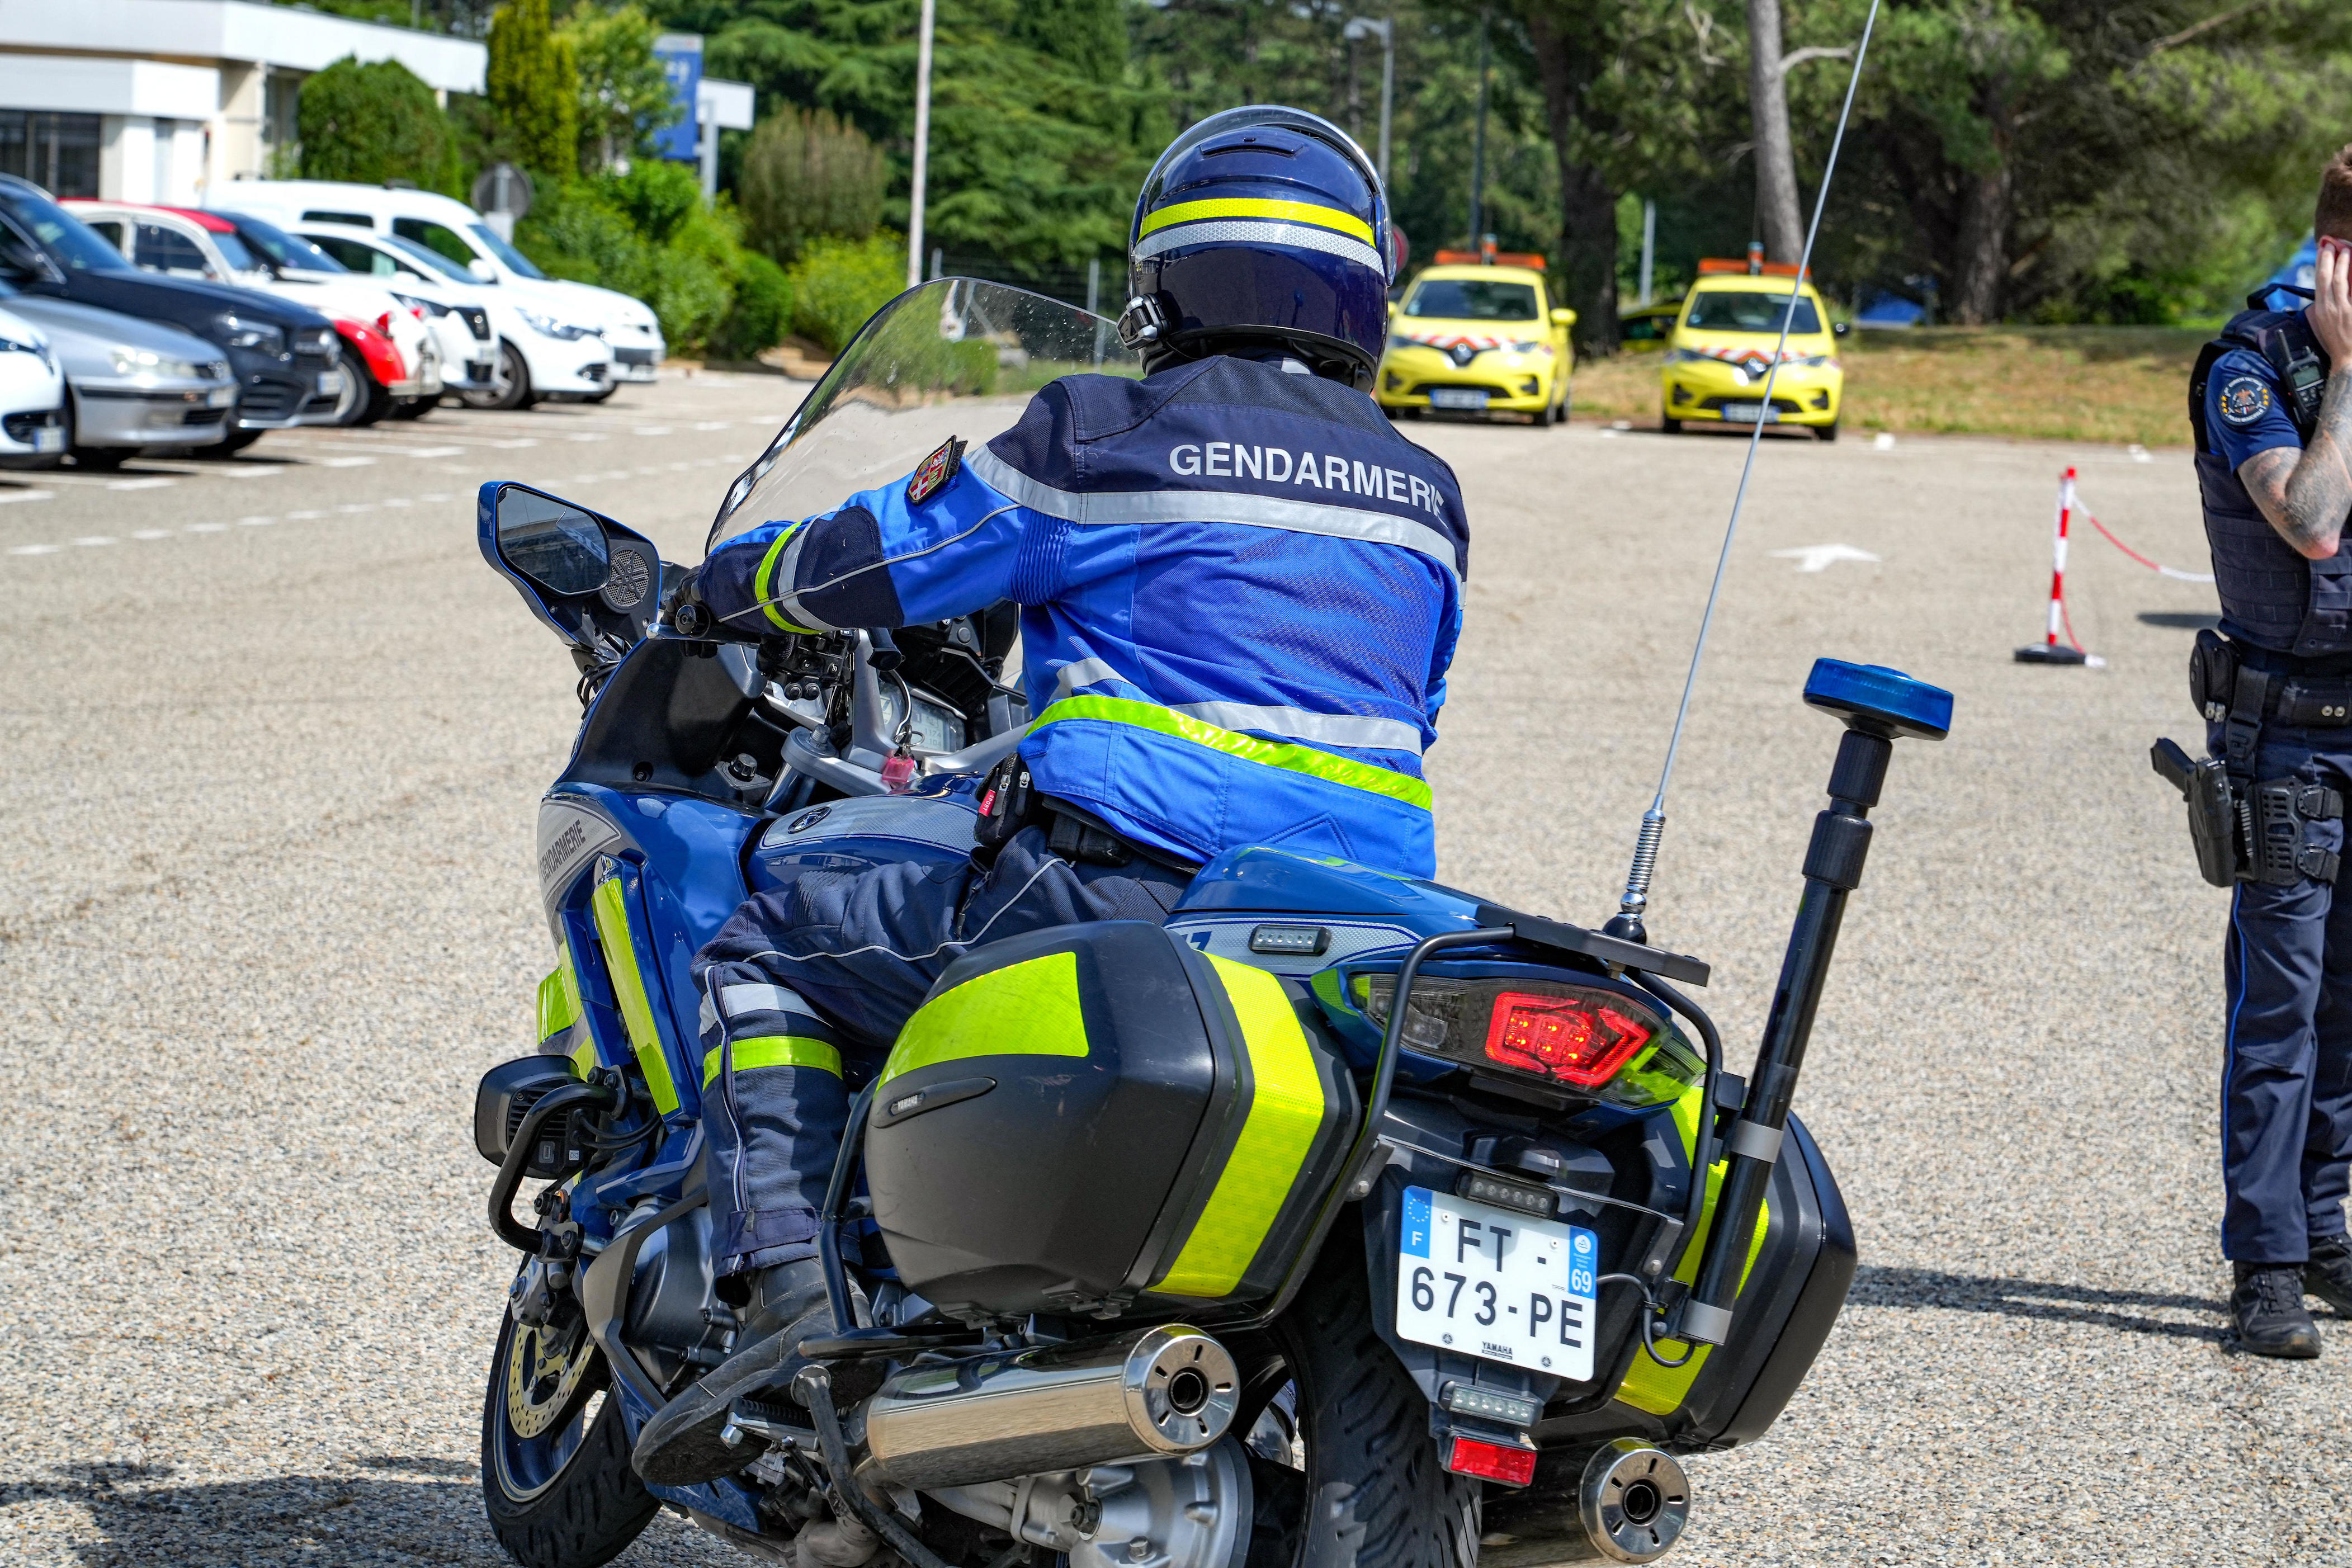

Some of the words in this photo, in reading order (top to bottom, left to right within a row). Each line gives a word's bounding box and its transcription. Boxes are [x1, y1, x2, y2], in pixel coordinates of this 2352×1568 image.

[982, 794, 994, 811] SPORT
[540, 819, 586, 884] GENDARMERIE
[1411, 1231, 1423, 1246] F
[1571, 1268, 1593, 1293] 69
[1411, 1266, 1583, 1349] 673-PE
[1482, 1341, 1513, 1355] YAMAHA
